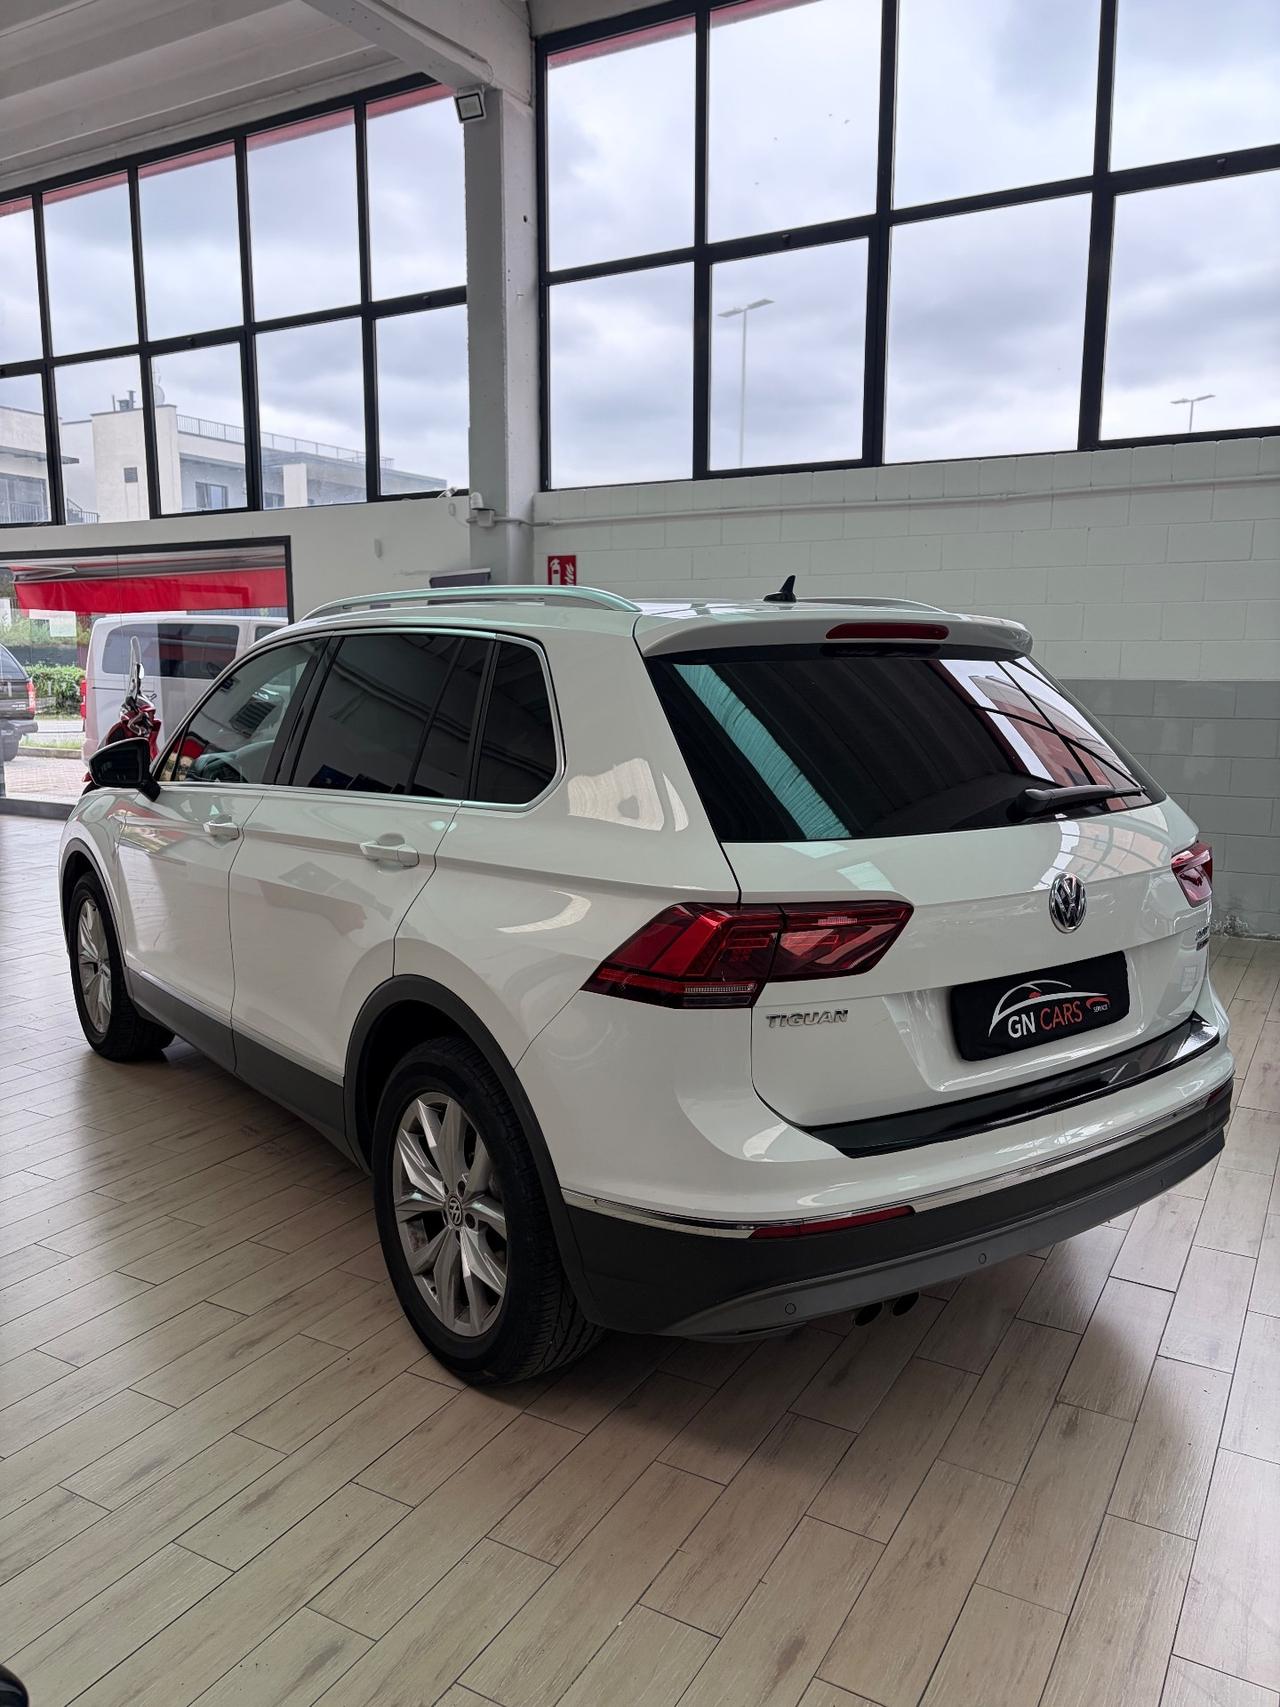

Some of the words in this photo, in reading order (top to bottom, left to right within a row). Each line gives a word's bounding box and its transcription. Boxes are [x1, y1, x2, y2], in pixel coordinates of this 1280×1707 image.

[766, 1009, 848, 1028] TIGUAN
[1008, 1012, 1036, 1038] GN
[1040, 1001, 1083, 1030] CARS
